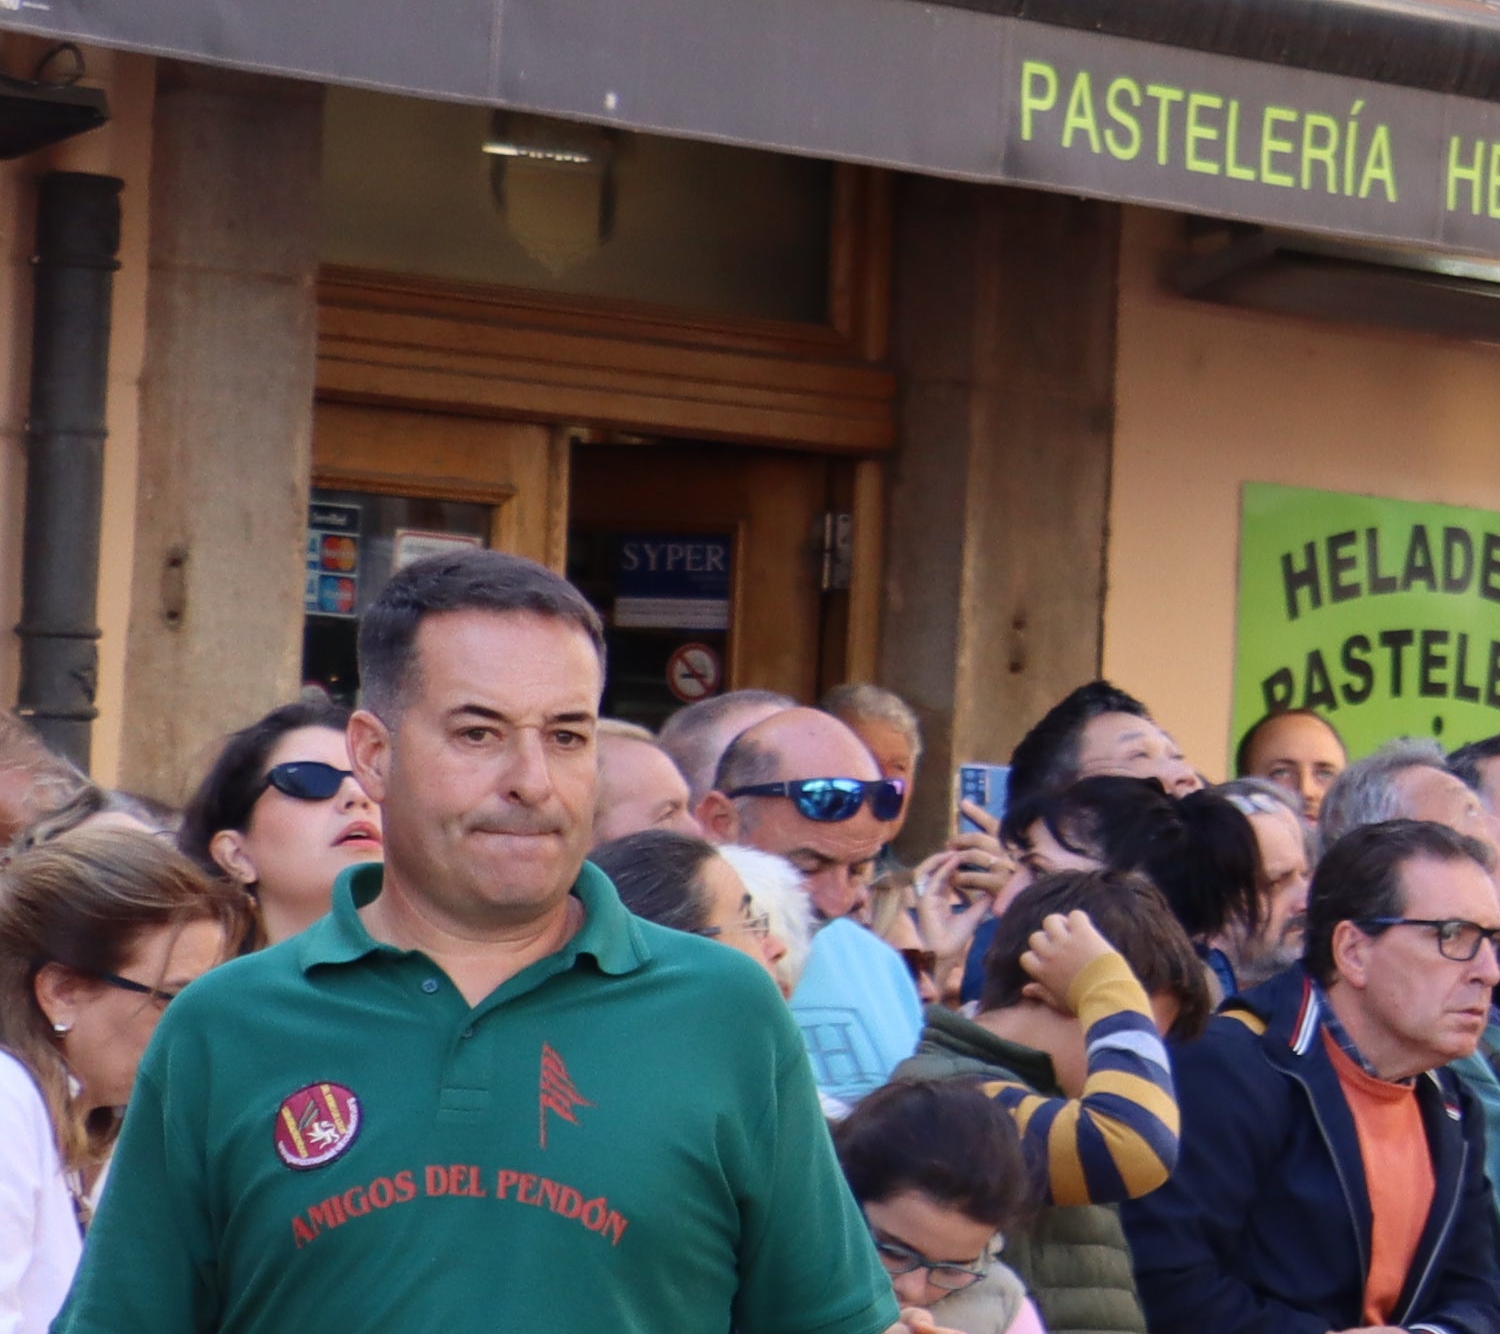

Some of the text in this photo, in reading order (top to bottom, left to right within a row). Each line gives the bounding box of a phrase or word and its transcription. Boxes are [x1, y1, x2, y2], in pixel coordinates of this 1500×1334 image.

[1020, 60, 1398, 204] PASTELERÍA
[622, 542, 727, 573] SYPER
[290, 1163, 629, 1249] AMIGOS DEL PENDÓN
